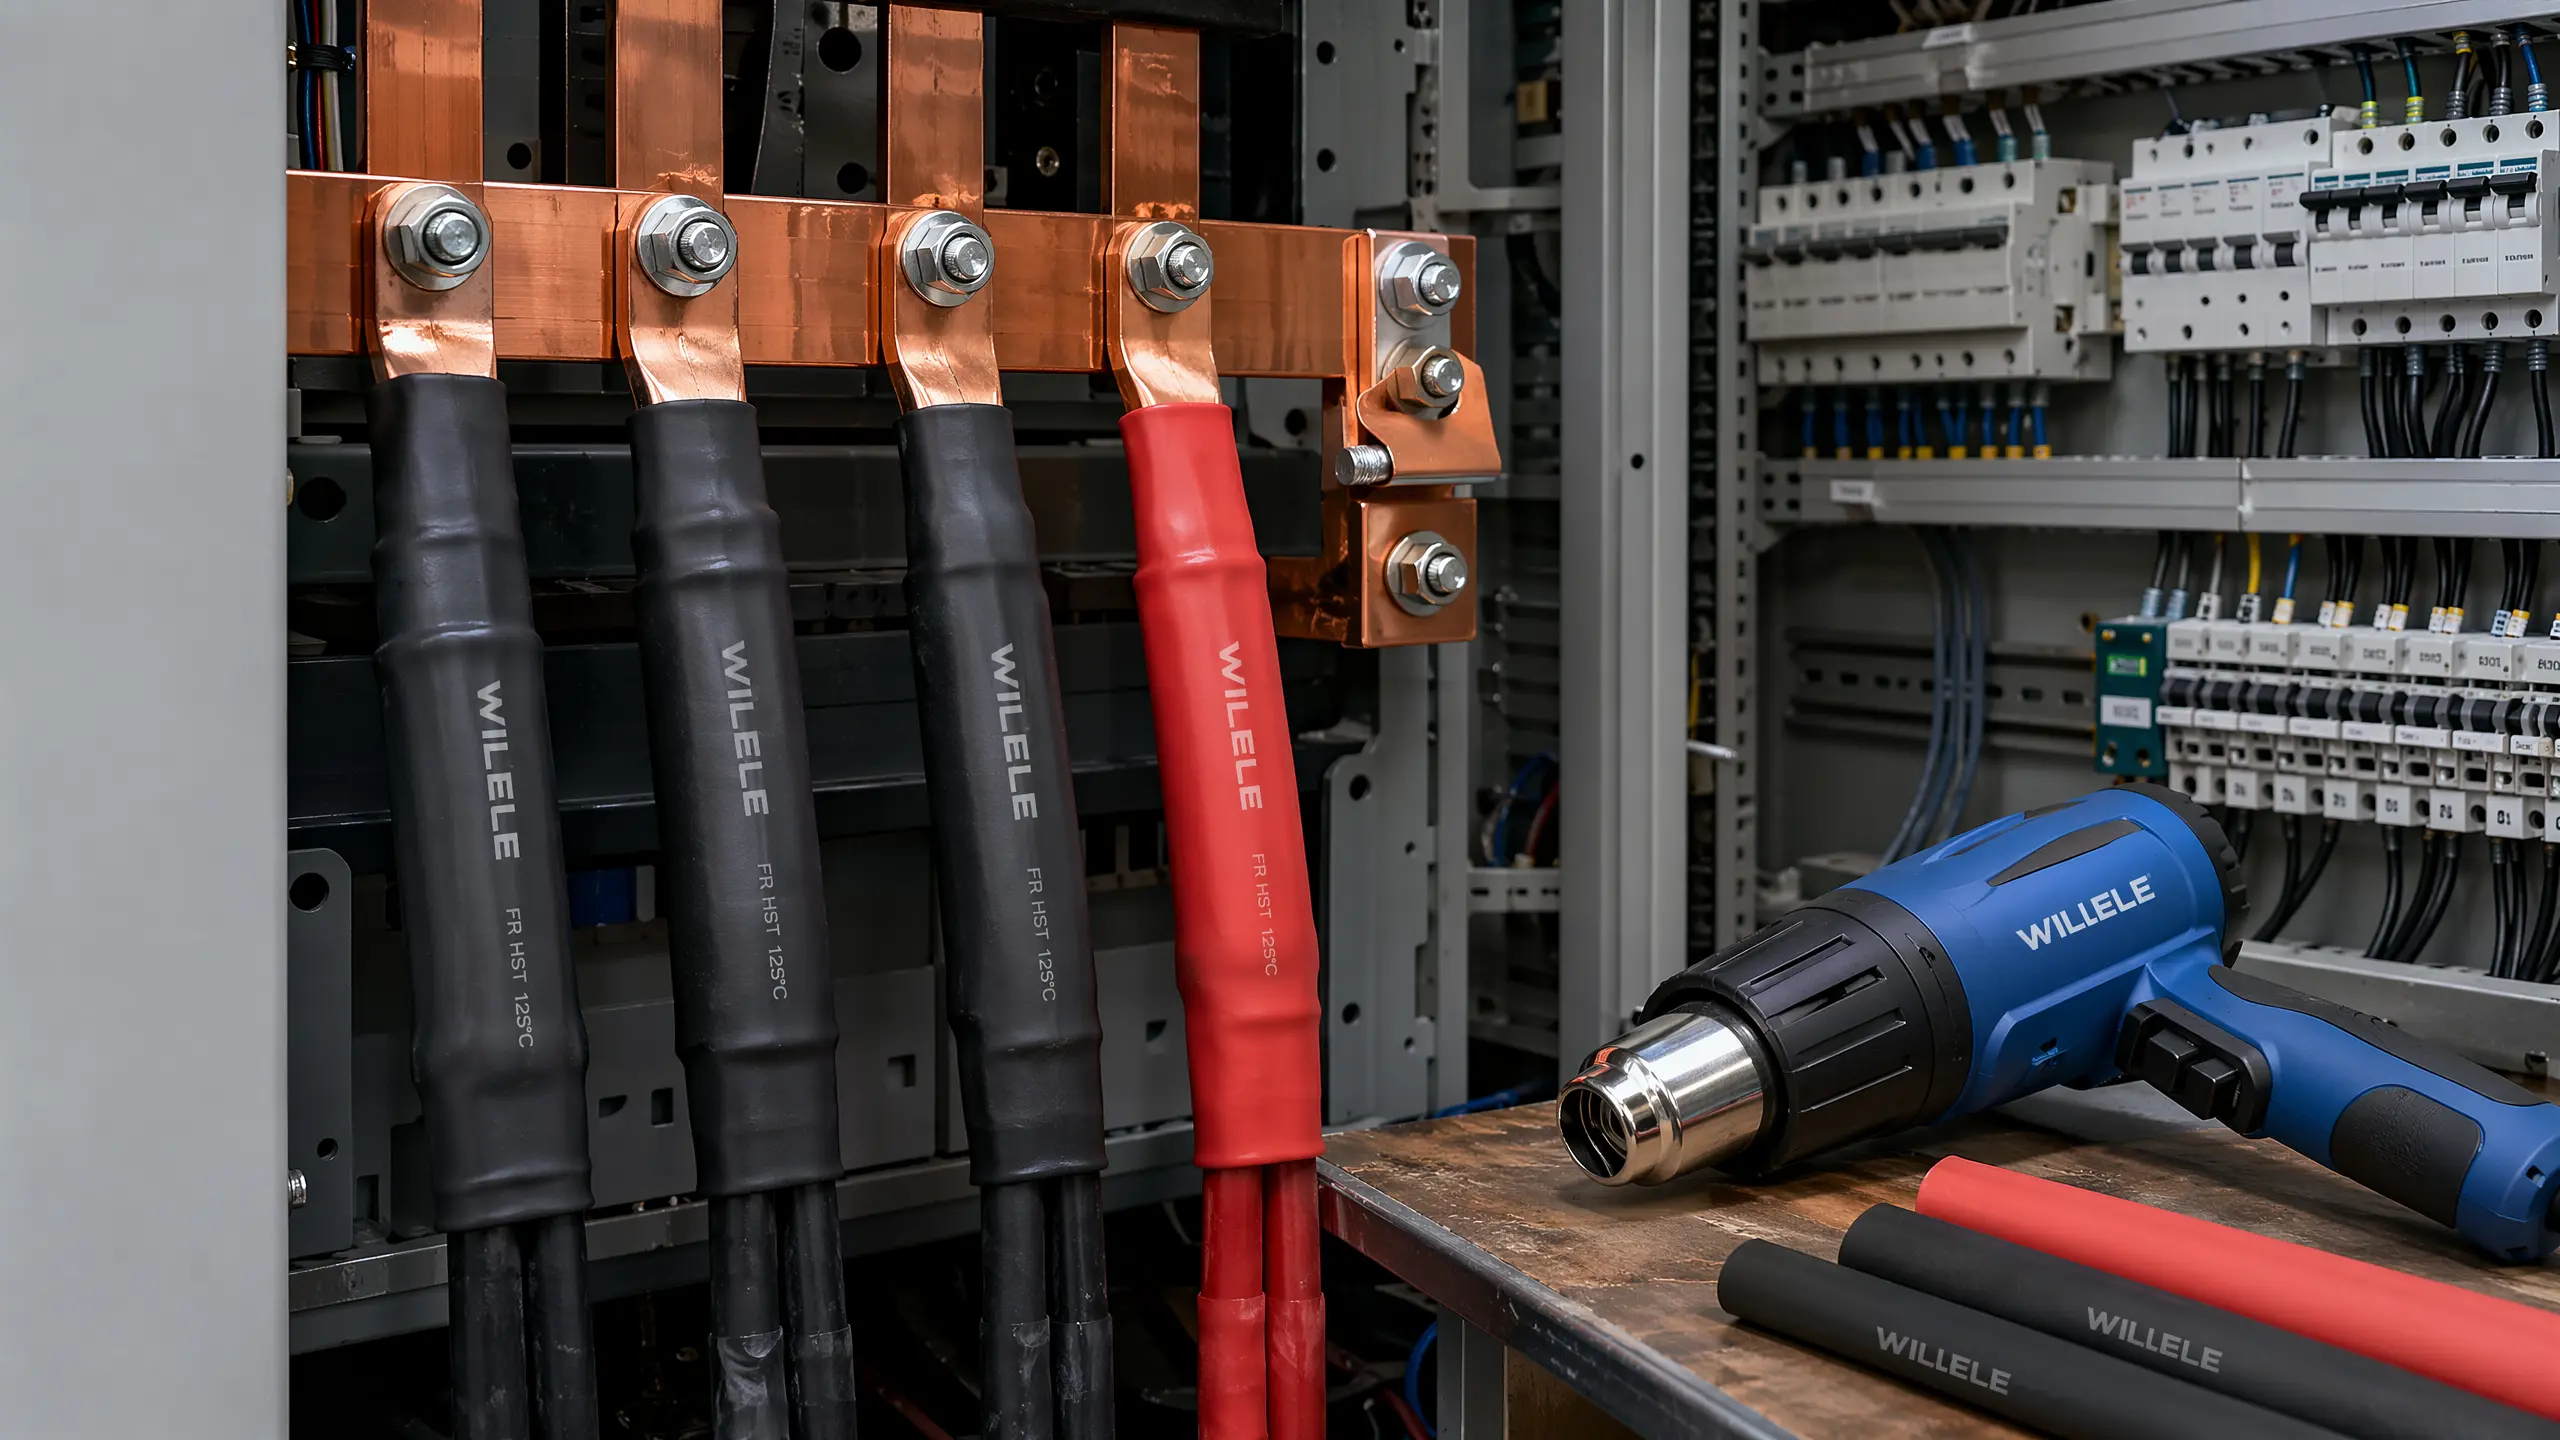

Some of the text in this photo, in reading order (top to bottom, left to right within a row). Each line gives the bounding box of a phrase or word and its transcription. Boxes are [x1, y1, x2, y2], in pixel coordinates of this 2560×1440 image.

[721, 640, 770, 817] WILELE
[991, 642, 1038, 821] WILELE
[1218, 640, 1263, 811] WILELE
[476, 680, 521, 861] WILELE
[757, 863, 774, 890] FR
[1026, 867, 1043, 894] FR
[1252, 853, 1267, 877] FR
[505, 907, 522, 935] FR
[762, 896, 781, 936] HST
[1031, 900, 1050, 940] HST
[1255, 883, 1272, 919] HST
[2015, 874, 2156, 951] WILLELE
[509, 941, 528, 983] HST
[1876, 1326, 2012, 1396] WILLELE
[2087, 1306, 2223, 1374] WILLELE
